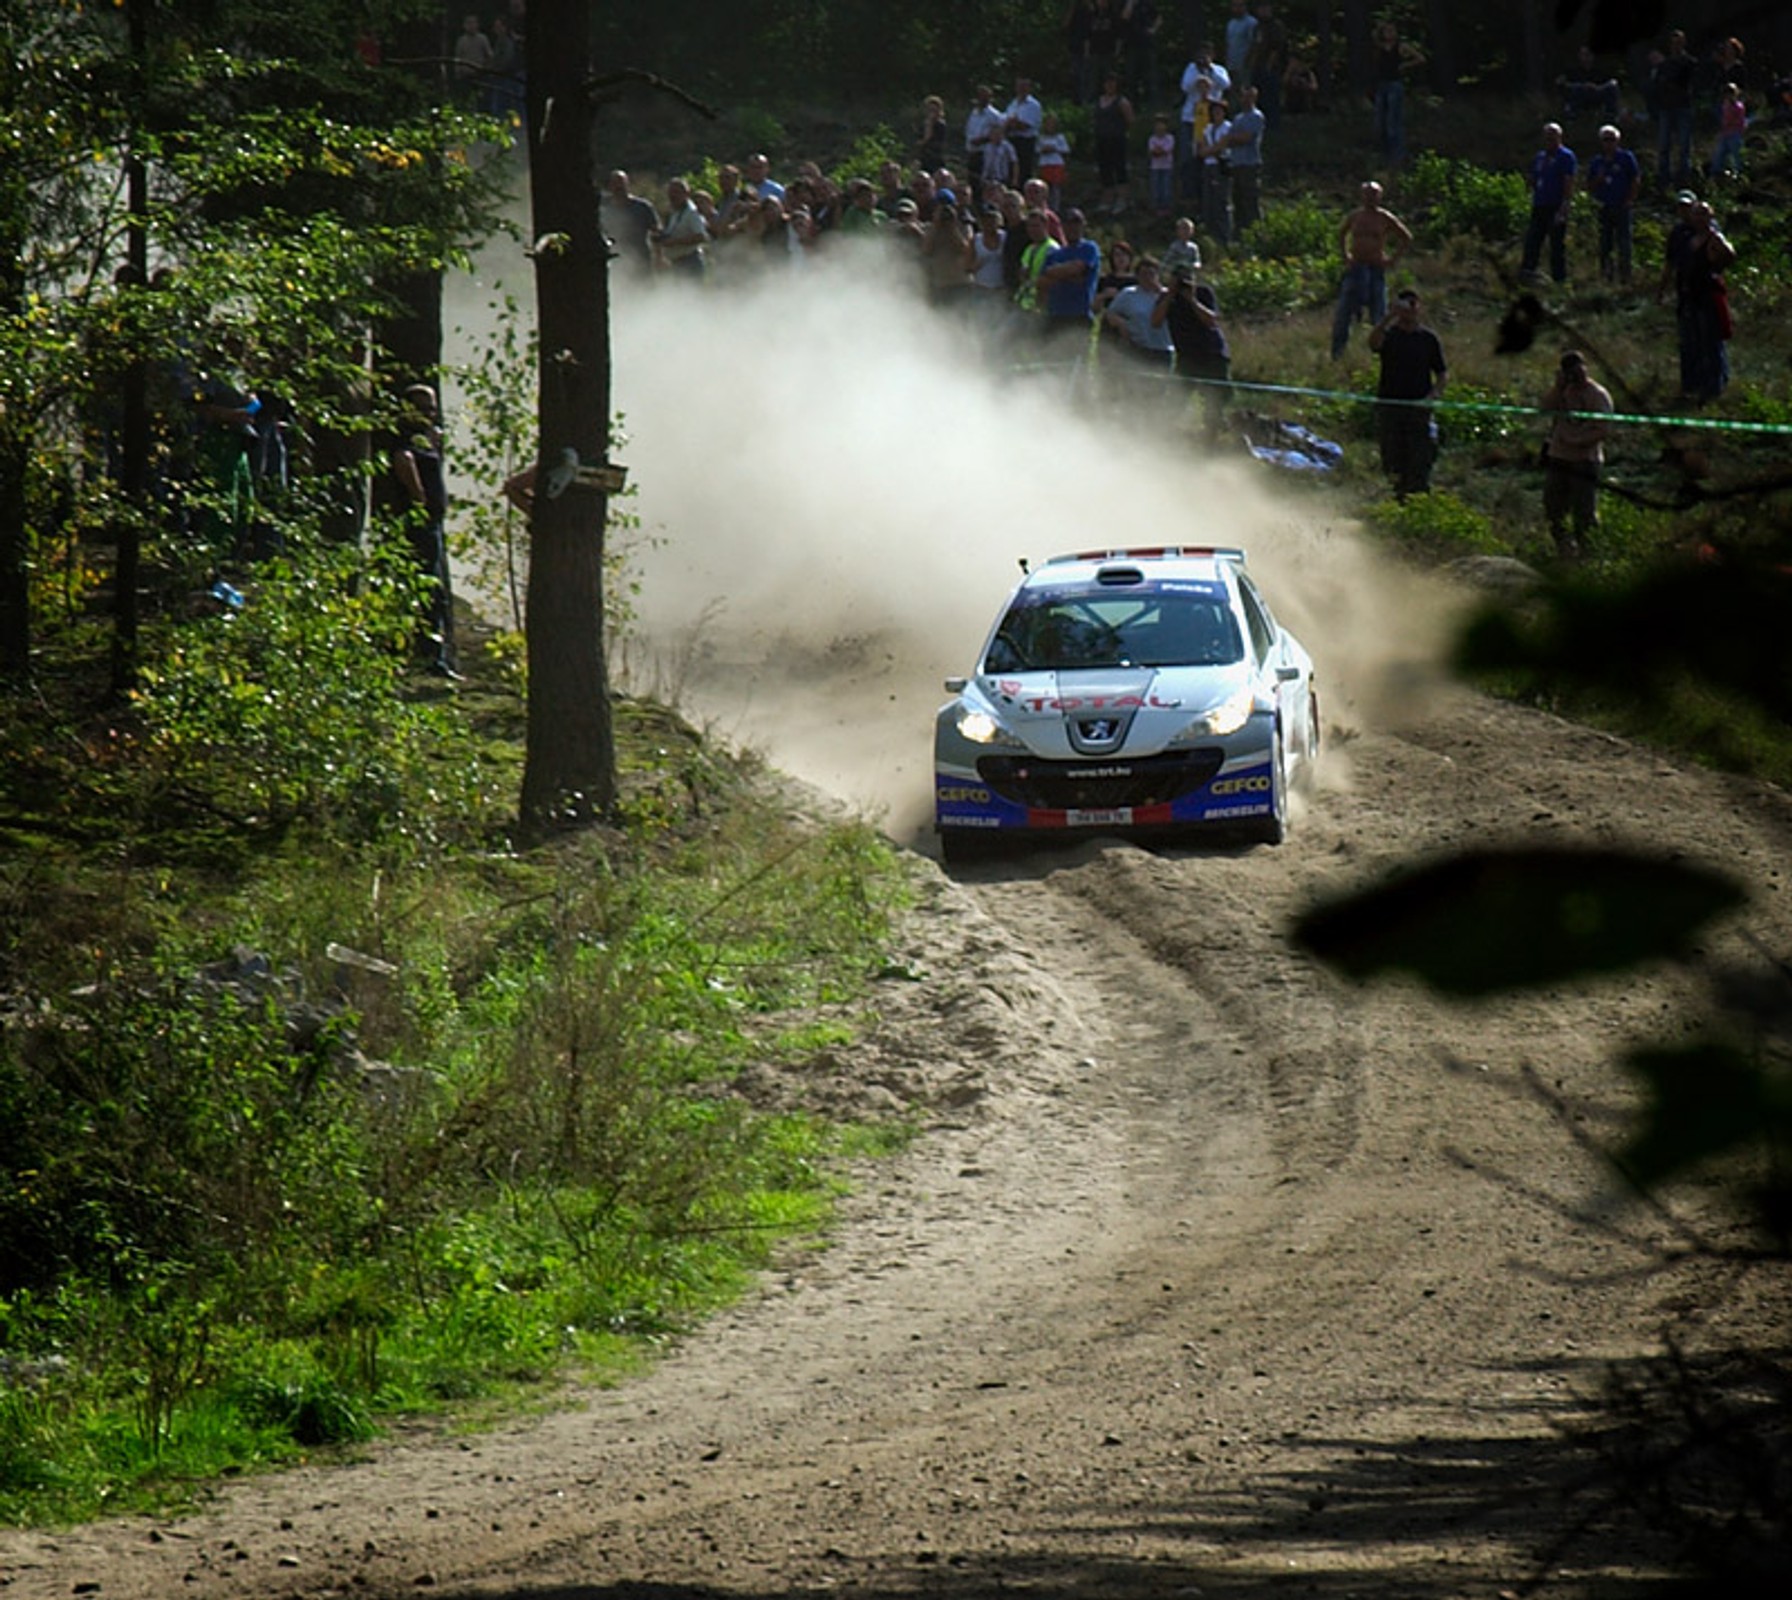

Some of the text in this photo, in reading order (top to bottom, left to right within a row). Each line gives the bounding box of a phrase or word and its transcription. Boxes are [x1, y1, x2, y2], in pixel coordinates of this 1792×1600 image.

[1025, 696, 1181, 712] TOTAL
[1210, 776, 1270, 795] GEFCO
[938, 786, 991, 803] GEFCO
[1203, 804, 1270, 820] MICHELIN
[941, 814, 1000, 827] MICHELIN
